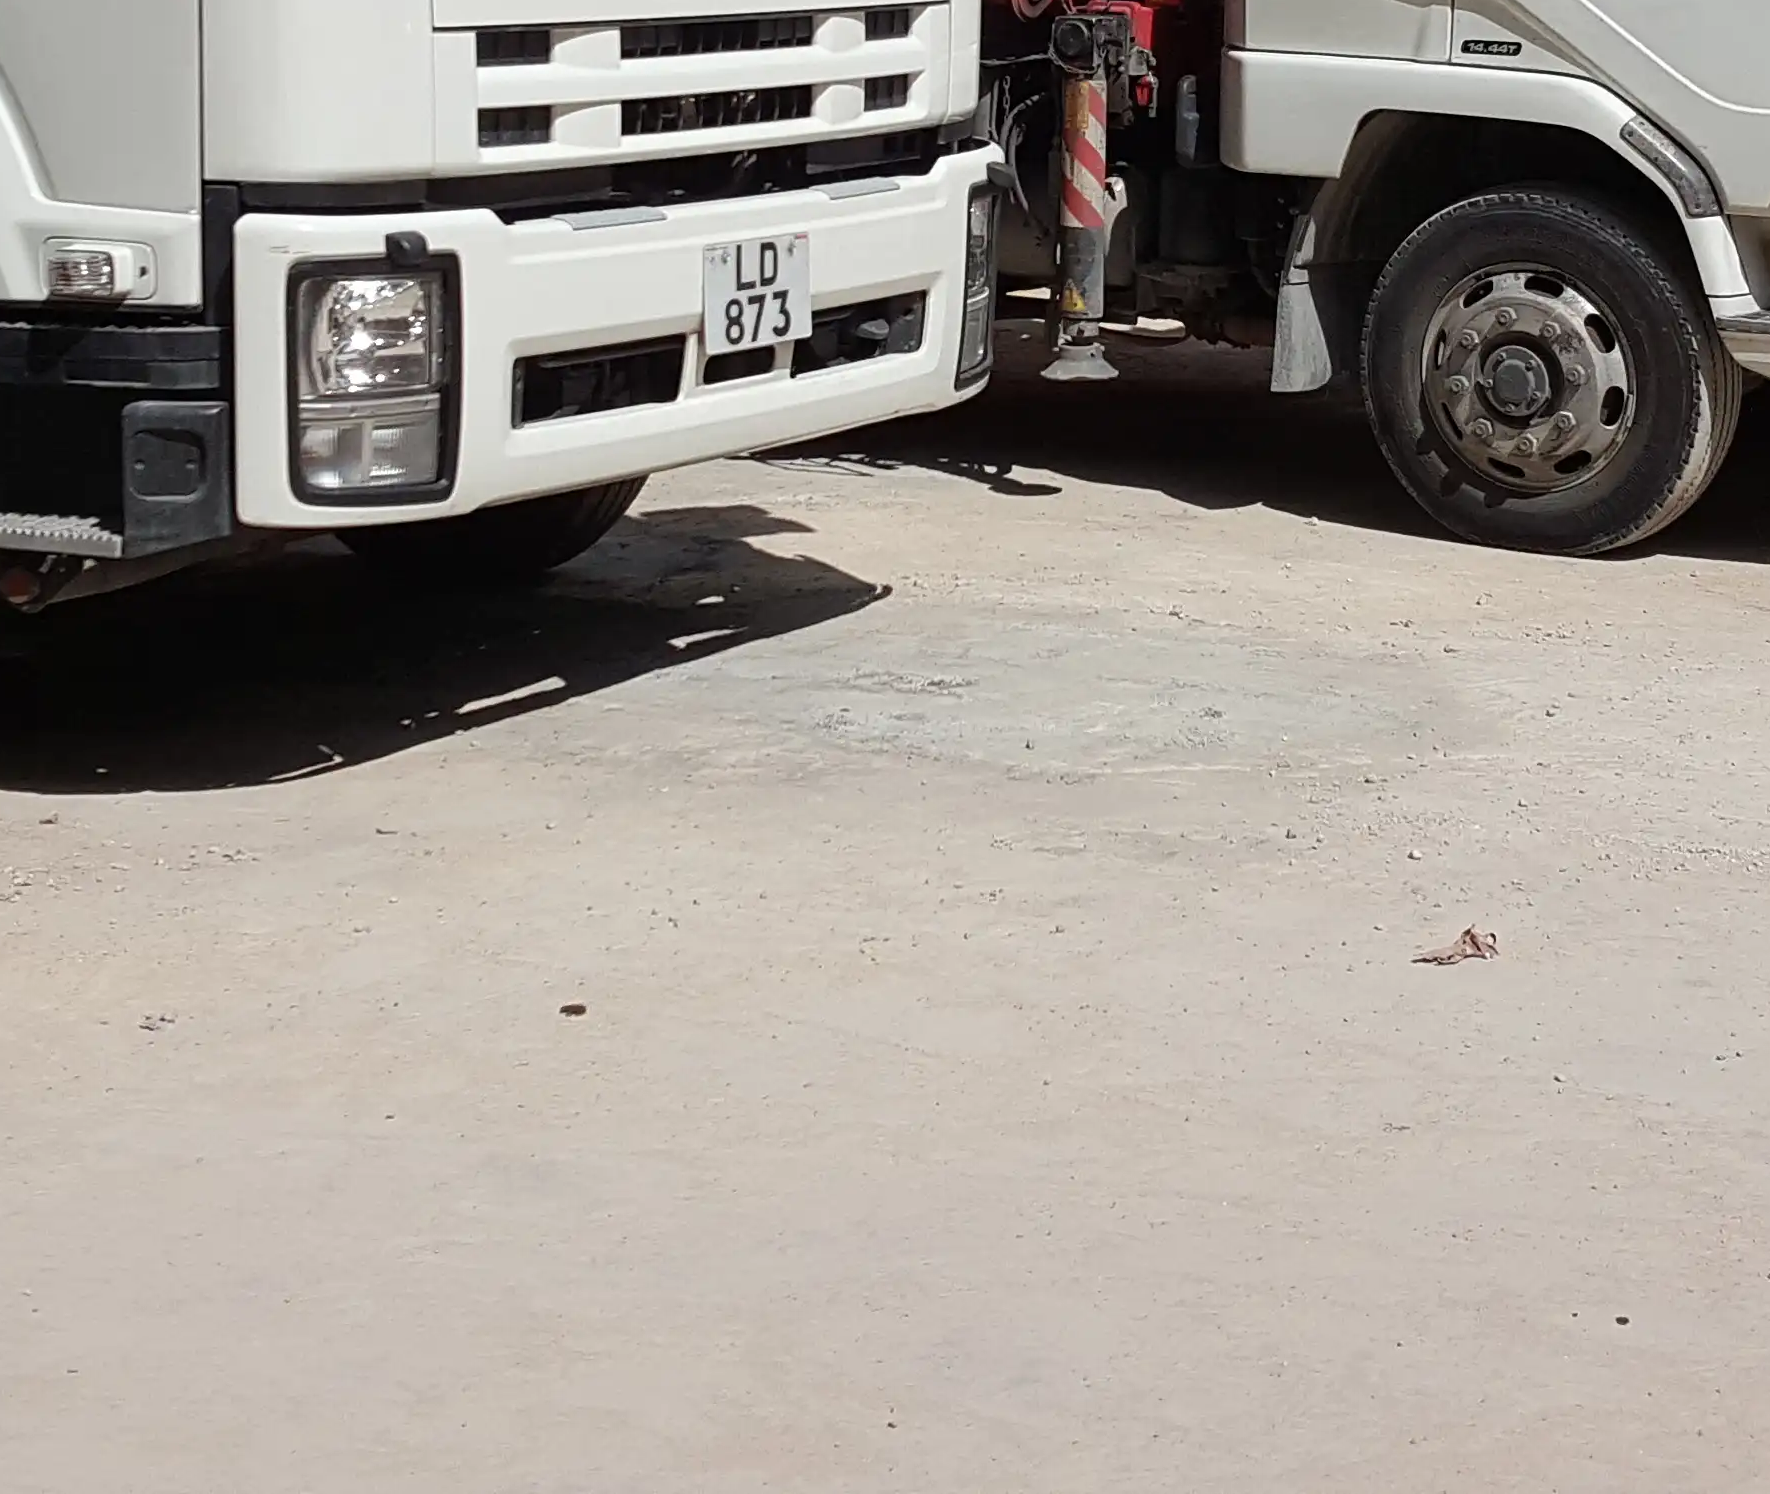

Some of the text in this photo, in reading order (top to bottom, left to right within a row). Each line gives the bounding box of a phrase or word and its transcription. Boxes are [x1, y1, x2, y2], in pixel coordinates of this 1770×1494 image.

[1467, 43, 1518, 55] 14.44T
[736, 241, 778, 291] LD
[725, 289, 792, 345] 873
